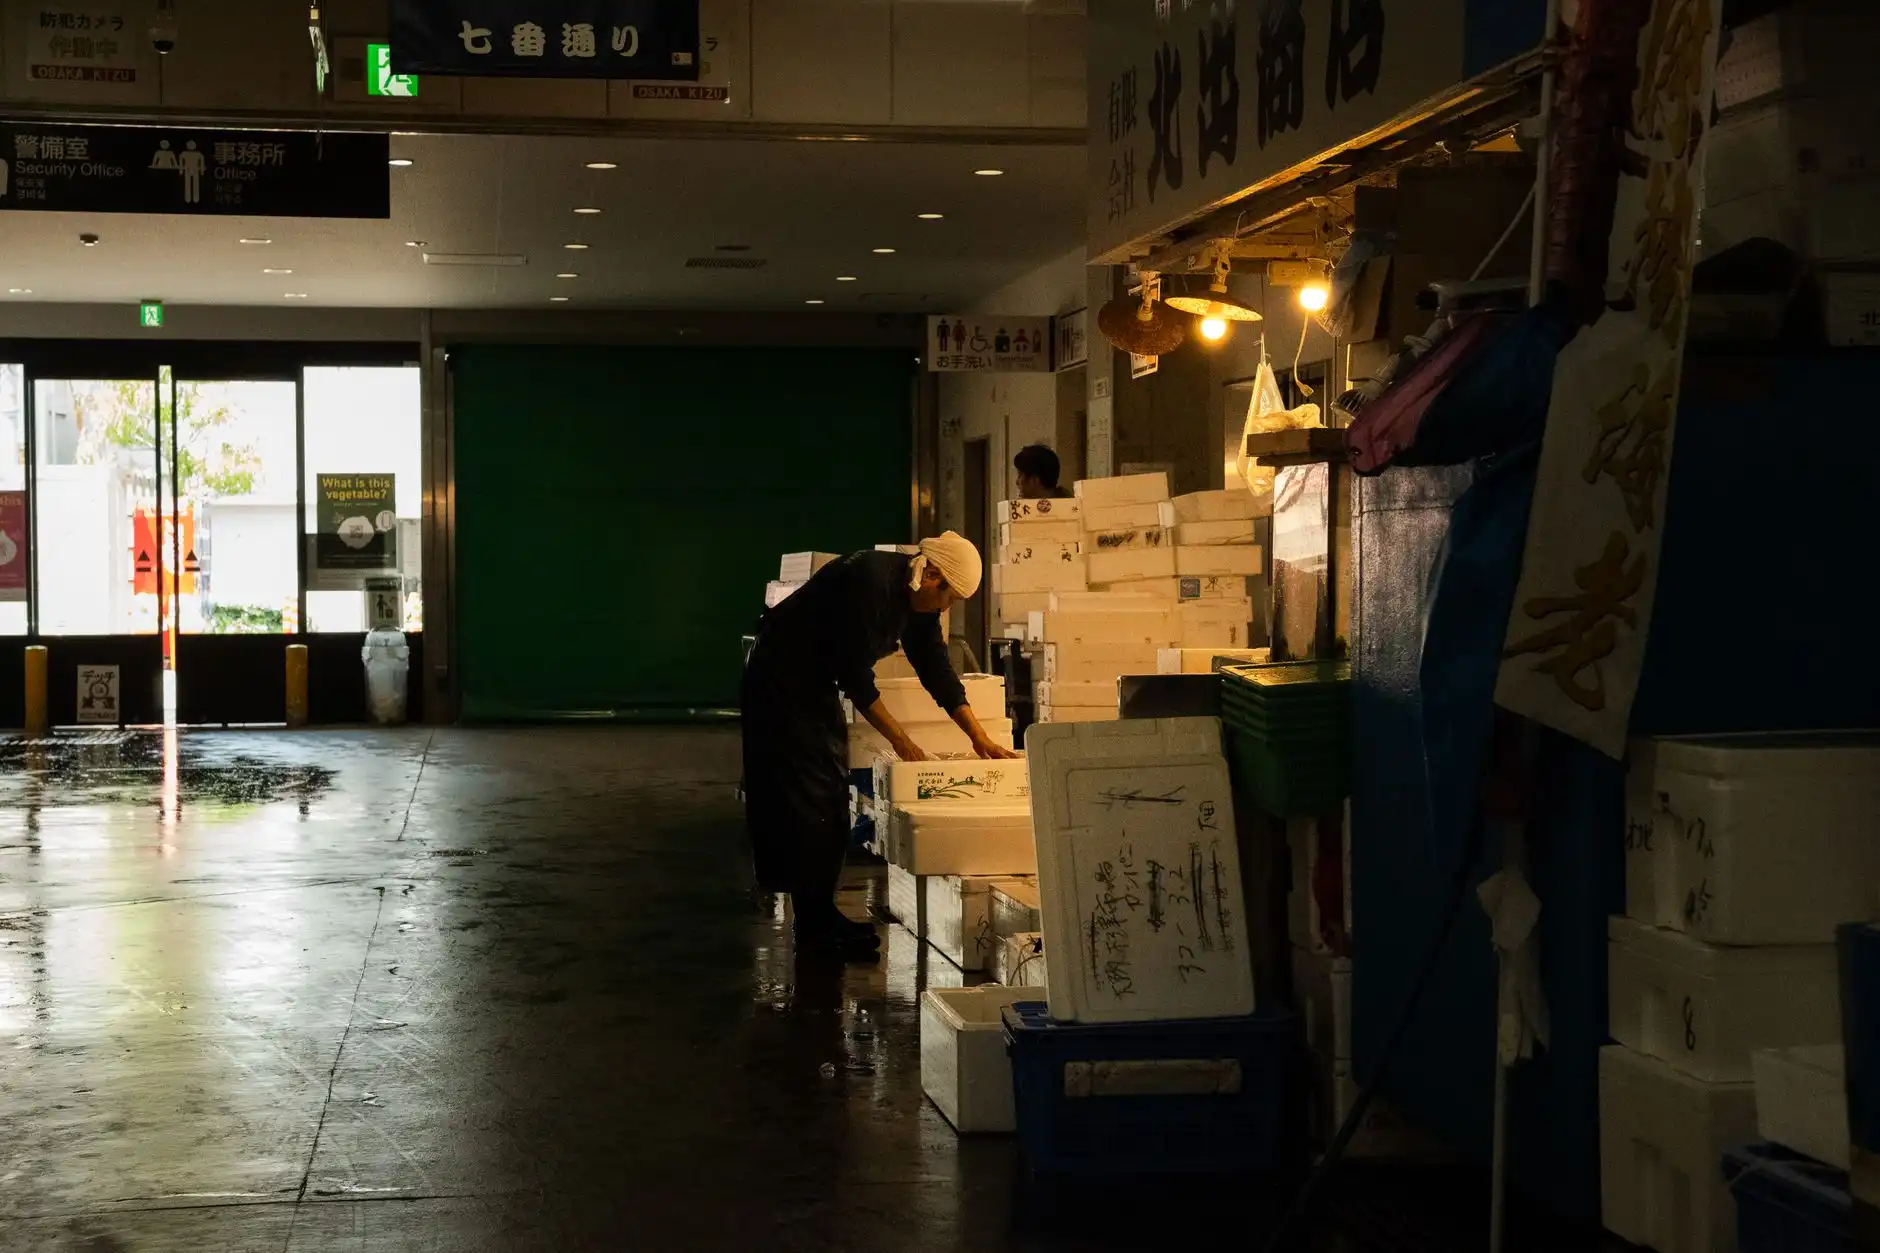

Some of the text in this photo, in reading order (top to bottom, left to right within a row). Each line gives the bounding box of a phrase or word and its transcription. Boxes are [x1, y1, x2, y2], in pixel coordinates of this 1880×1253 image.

[40, 10, 125, 31] 防犯カメラ
[457, 19, 639, 58] 七番通り
[37, 66, 84, 79] OSAKA
[637, 86, 722, 99] OSAKA KIZU
[14, 132, 91, 160] 警備室
[212, 141, 287, 168] 事務所
[15, 160, 126, 180] Security Office
[213, 166, 259, 182] Office
[936, 355, 993, 369] お手洗い
[321, 477, 391, 489] What is this
[326, 489, 388, 501] vegetable?
